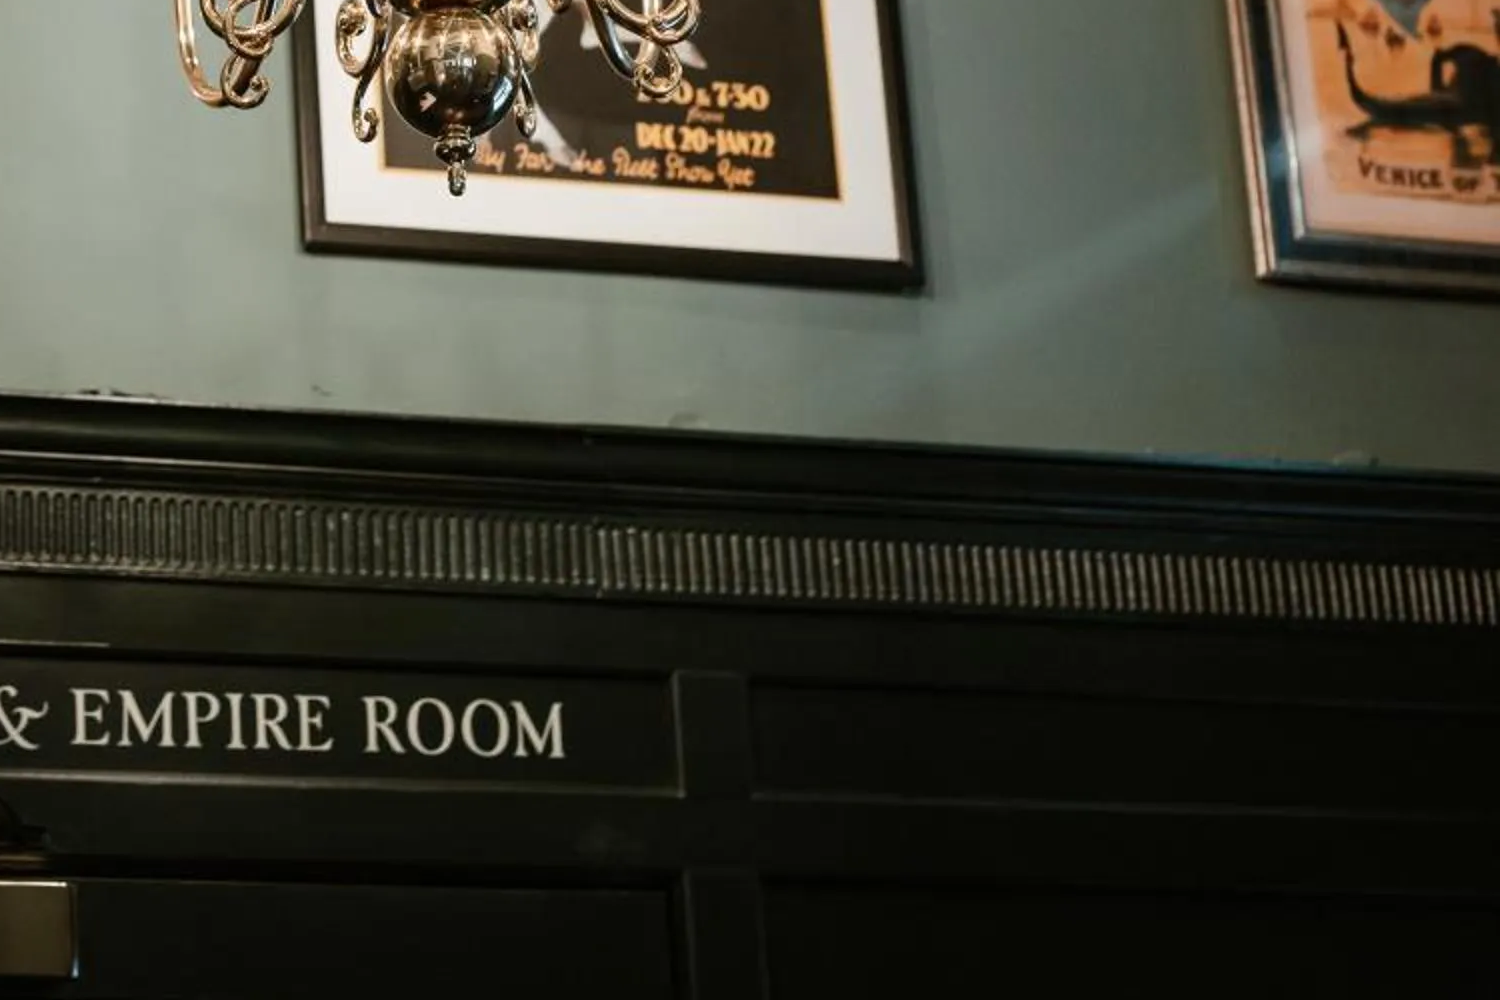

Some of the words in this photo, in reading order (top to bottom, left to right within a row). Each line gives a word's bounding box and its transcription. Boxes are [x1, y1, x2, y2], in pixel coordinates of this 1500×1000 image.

[1357, 156, 1443, 189] VENICE
[69, 688, 334, 752] EMPIRE
[362, 696, 565, 759] ROOM
